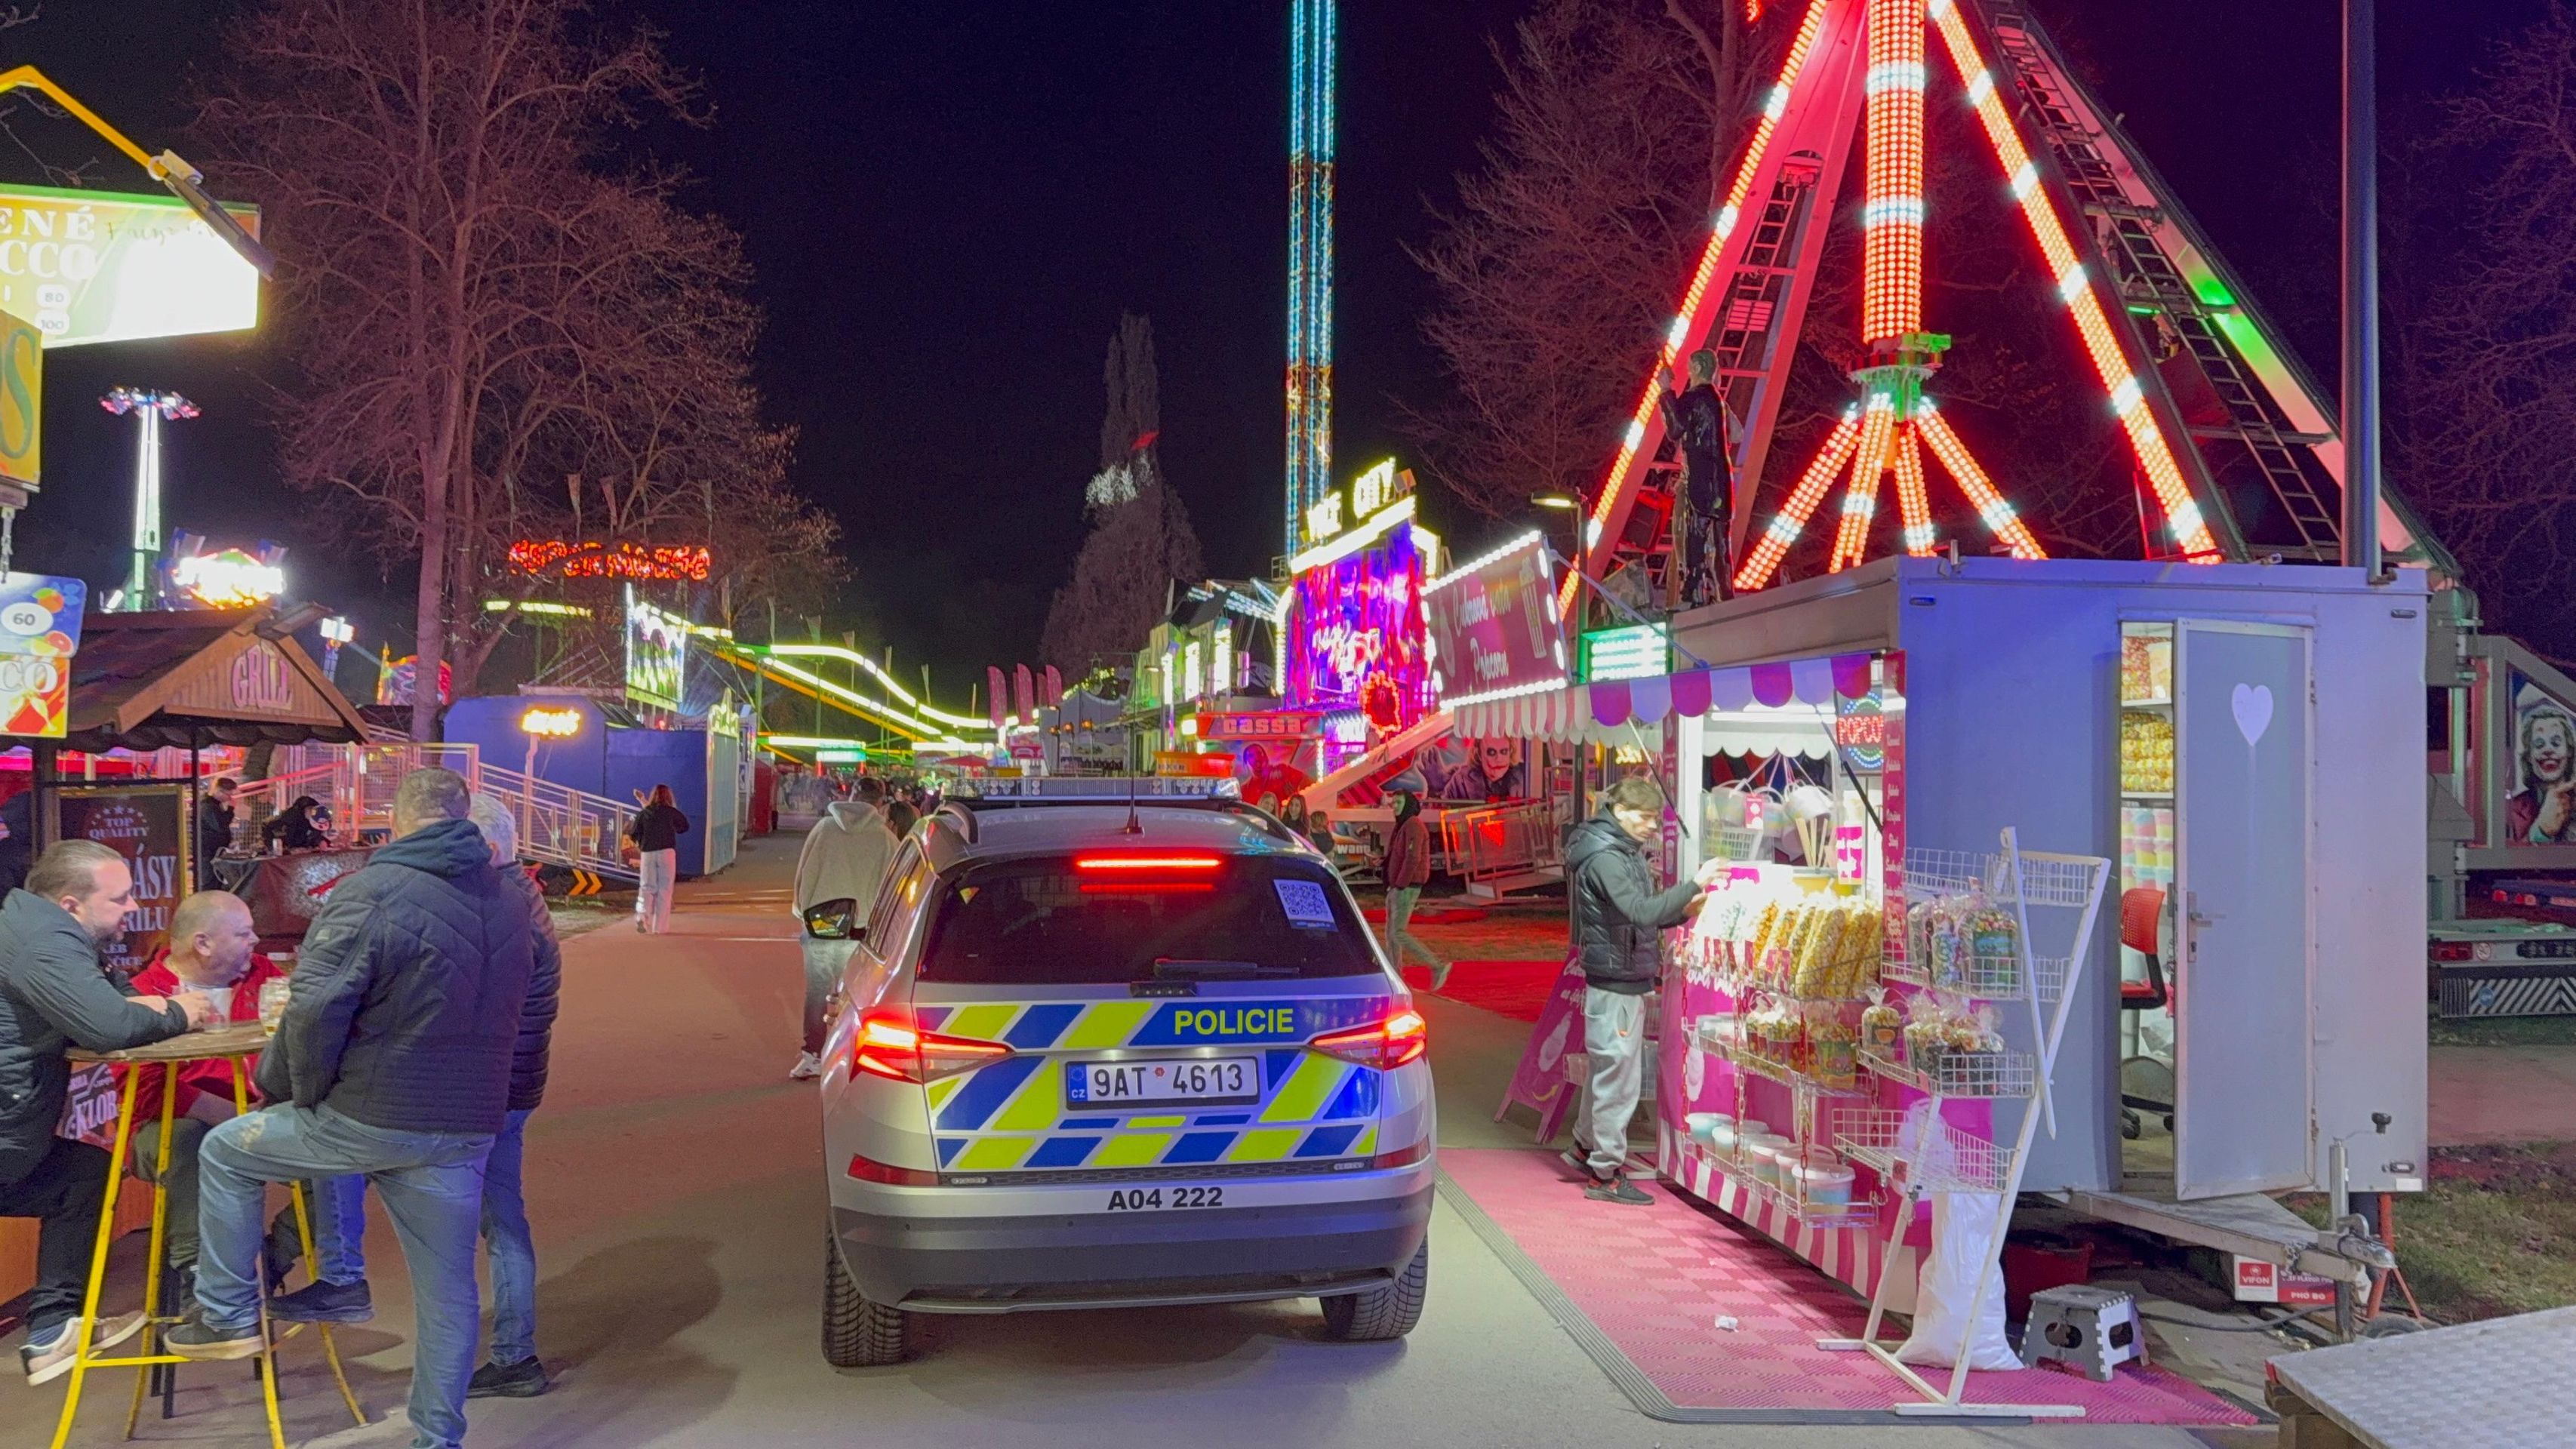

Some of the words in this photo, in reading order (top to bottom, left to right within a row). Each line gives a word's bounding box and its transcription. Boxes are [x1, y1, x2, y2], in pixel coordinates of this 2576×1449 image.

[45, 292, 65, 303] 80
[41, 319, 65, 331] 100
[13, 613, 36, 626] 60
[231, 638, 294, 710] GRILL
[1470, 637, 1510, 693] Popcorn
[105, 817, 134, 827] TOP
[89, 827, 149, 840] QUALITY
[125, 842, 177, 900] ÁSY
[1174, 1008, 1294, 1035] POLICIE
[1071, 1089, 1085, 1099] CZ
[1094, 1066, 1146, 1097] 9AT
[1172, 1063, 1243, 1094] 4613
[1107, 1188, 1162, 1211] A04
[1171, 1186, 1223, 1208] 222
[2242, 1276, 2271, 1284] VIFON
